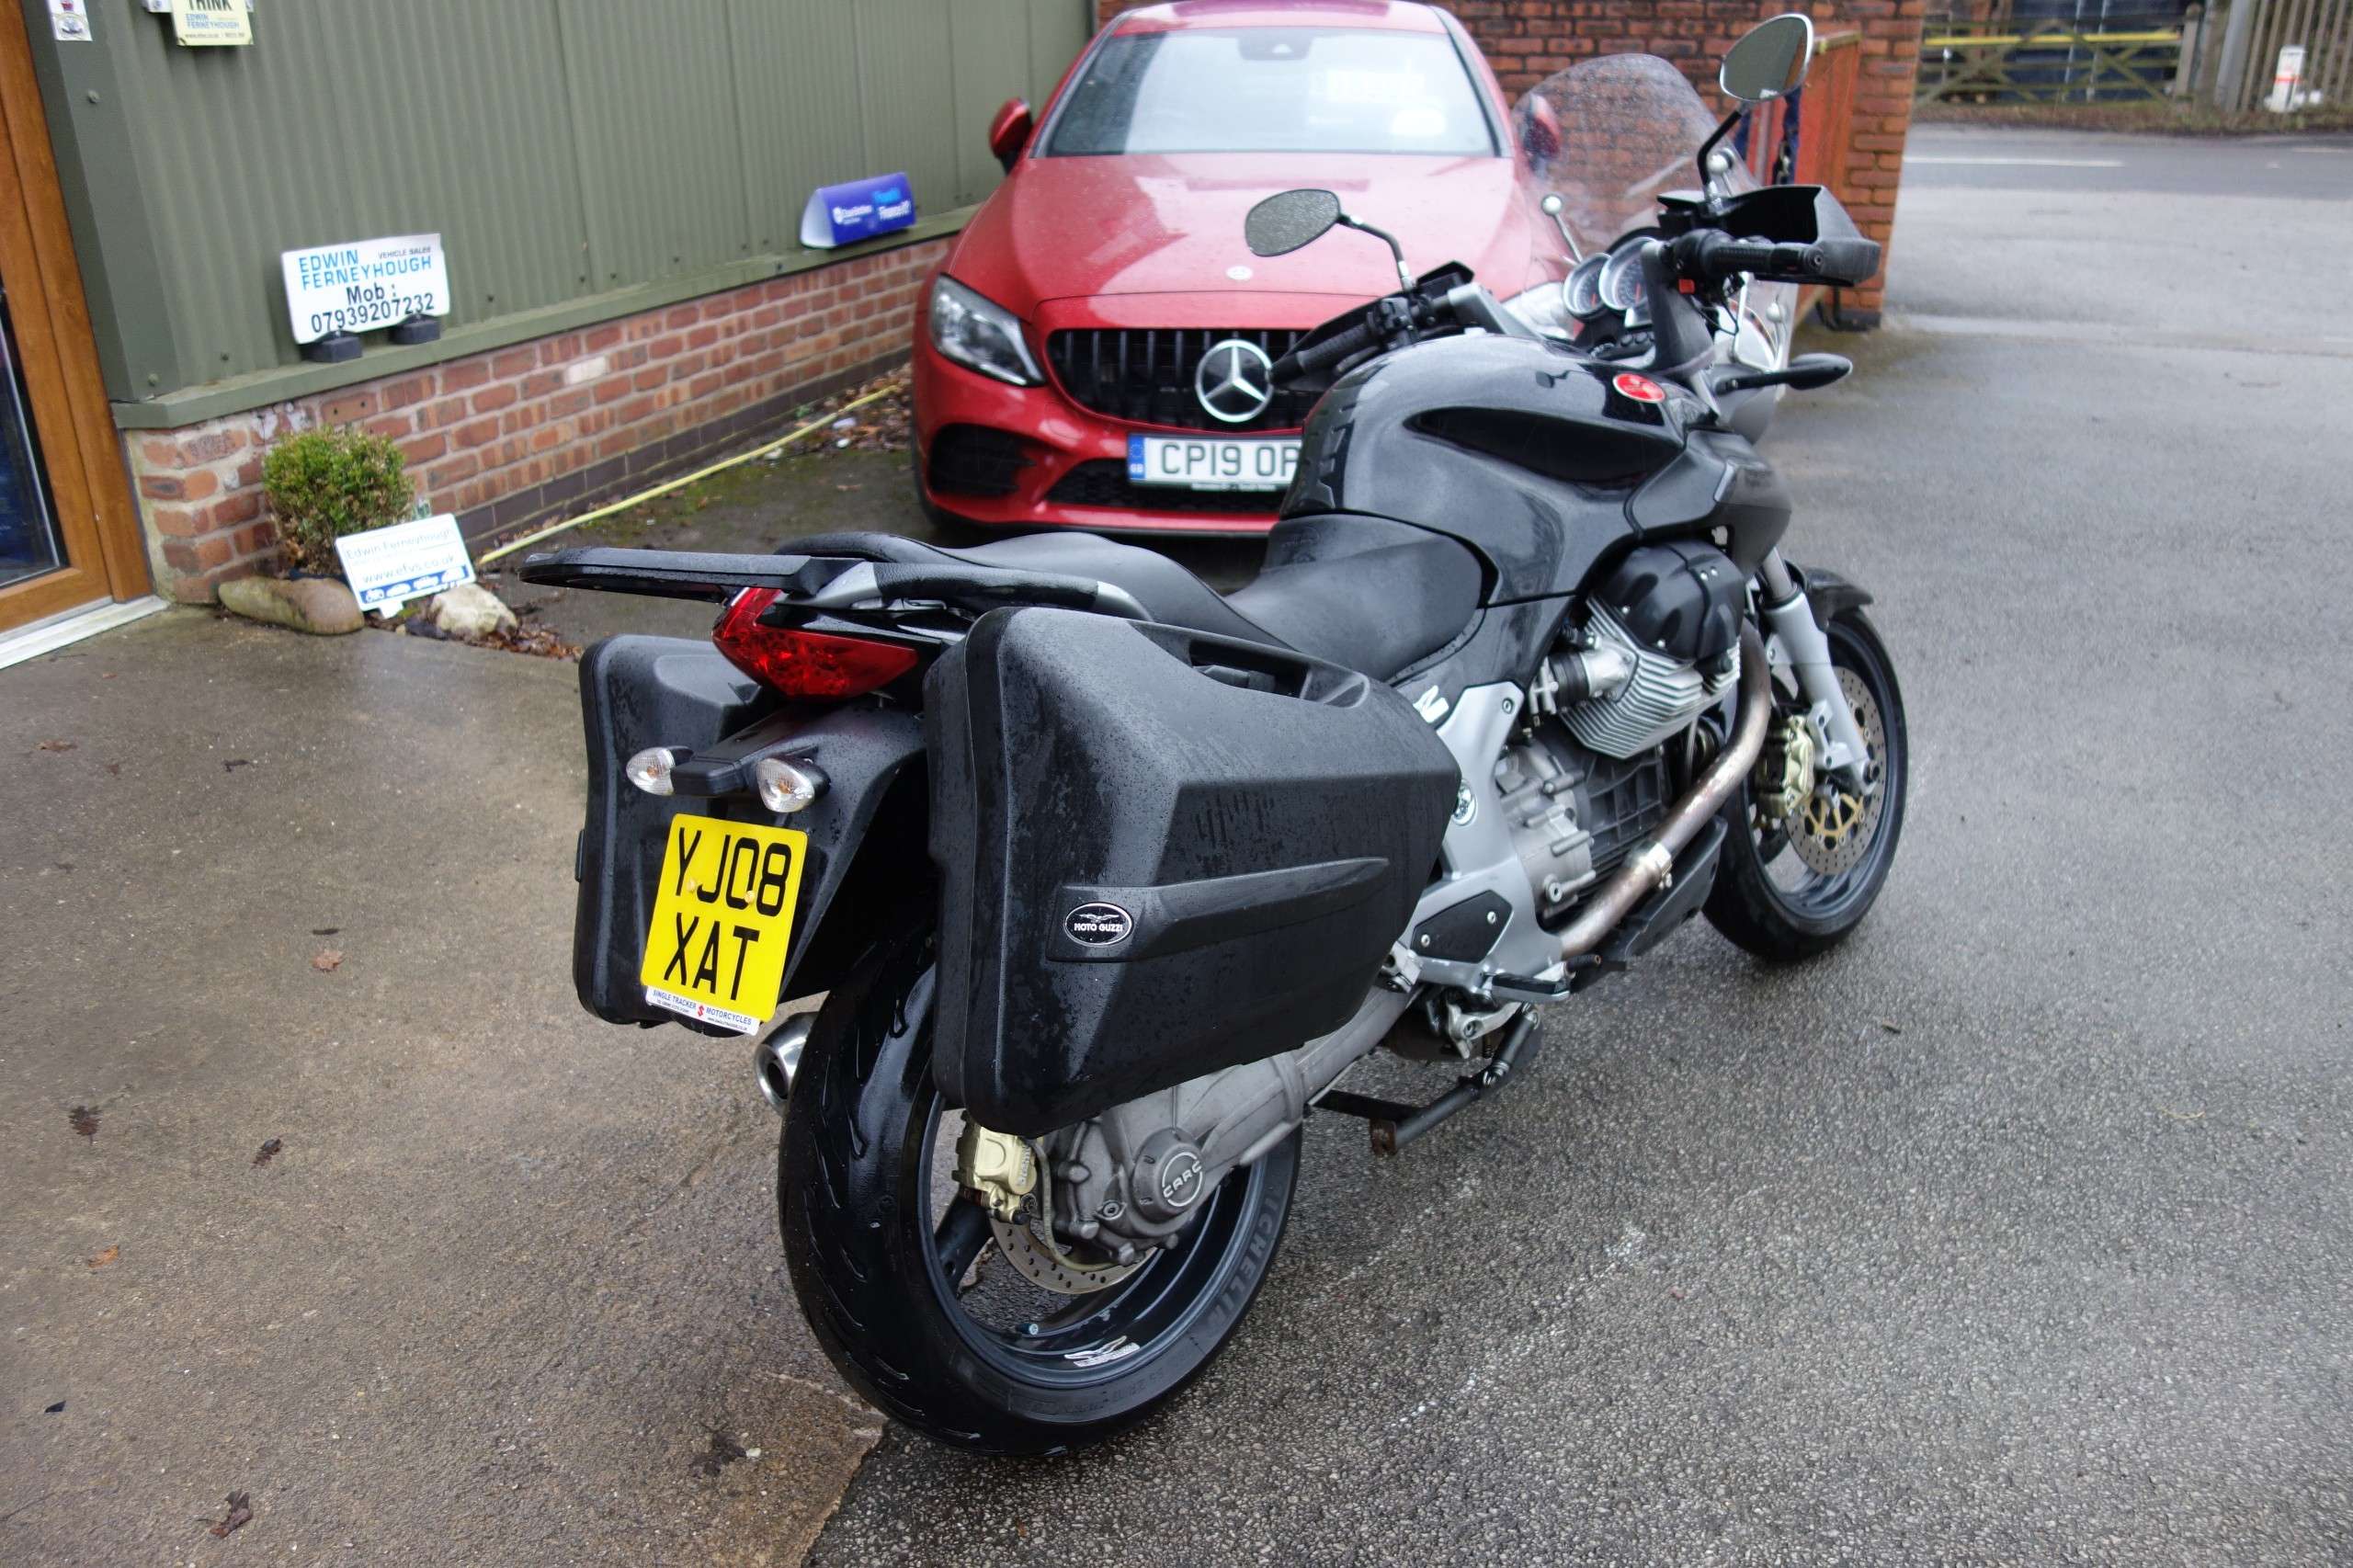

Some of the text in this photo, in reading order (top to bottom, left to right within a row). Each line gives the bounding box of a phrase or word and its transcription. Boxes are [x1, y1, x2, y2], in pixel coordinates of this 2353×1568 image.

[299, 249, 359, 273] EDWIN
[379, 249, 407, 259] VEHICLE
[301, 256, 432, 290] FERNEYHOUGH
[311, 292, 435, 333] 07939207232
[1161, 442, 1241, 476] CP19
[676, 827, 792, 917] YJ08
[1074, 923, 1123, 932] MOTO GUZZI
[664, 912, 760, 1001] XAT
[653, 989, 672, 1002] SINGLE
[672, 995, 697, 1009] TRACKER
[705, 1006, 752, 1026] MOTORCYCLES
[1163, 1160, 1202, 1198] CARC
[1208, 1182, 1280, 1324] ICHELIN
